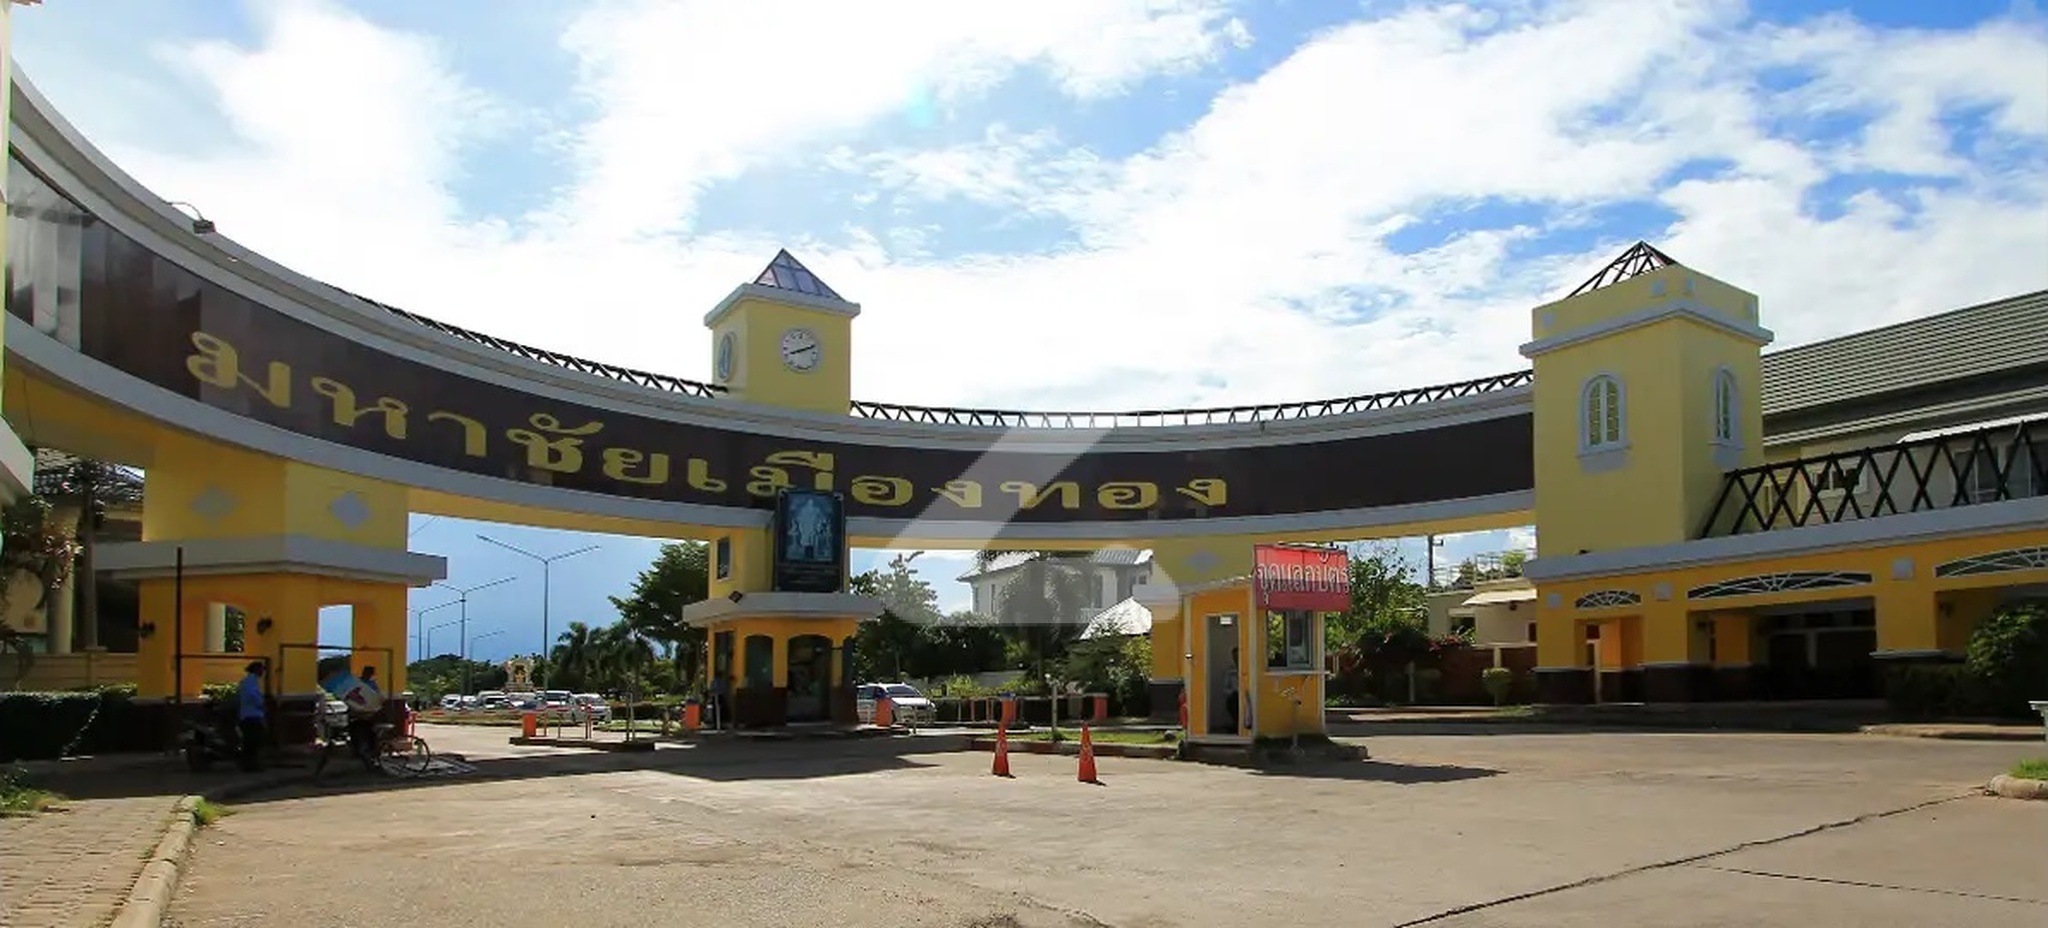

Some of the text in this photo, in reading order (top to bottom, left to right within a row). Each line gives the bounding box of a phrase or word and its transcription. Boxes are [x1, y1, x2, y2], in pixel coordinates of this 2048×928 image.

[186, 331, 1228, 509] มหาชัยเมืองทอง
